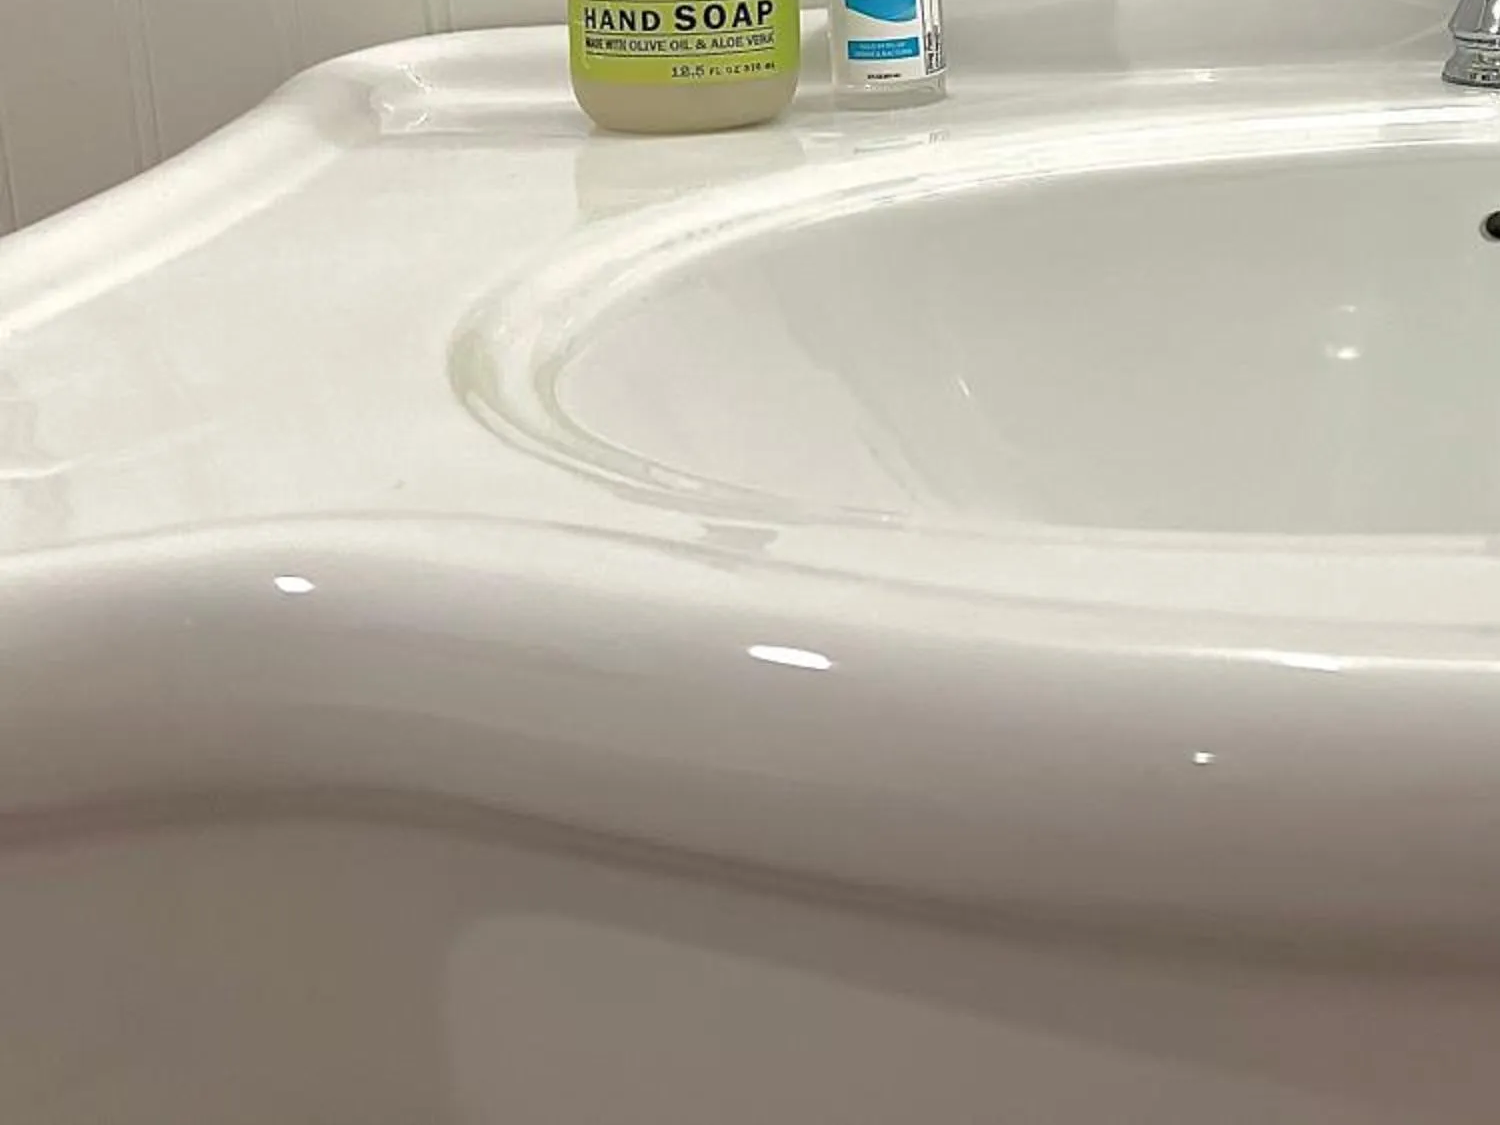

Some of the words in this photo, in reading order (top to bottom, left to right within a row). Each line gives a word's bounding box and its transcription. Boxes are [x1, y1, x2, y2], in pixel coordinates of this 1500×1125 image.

[584, 6, 661, 32] HAND
[674, 0, 774, 32] SOAP
[628, 37, 666, 52] OLIVE
[669, 37, 693, 51] OIL
[695, 36, 707, 49] &
[711, 34, 745, 49] ALOE
